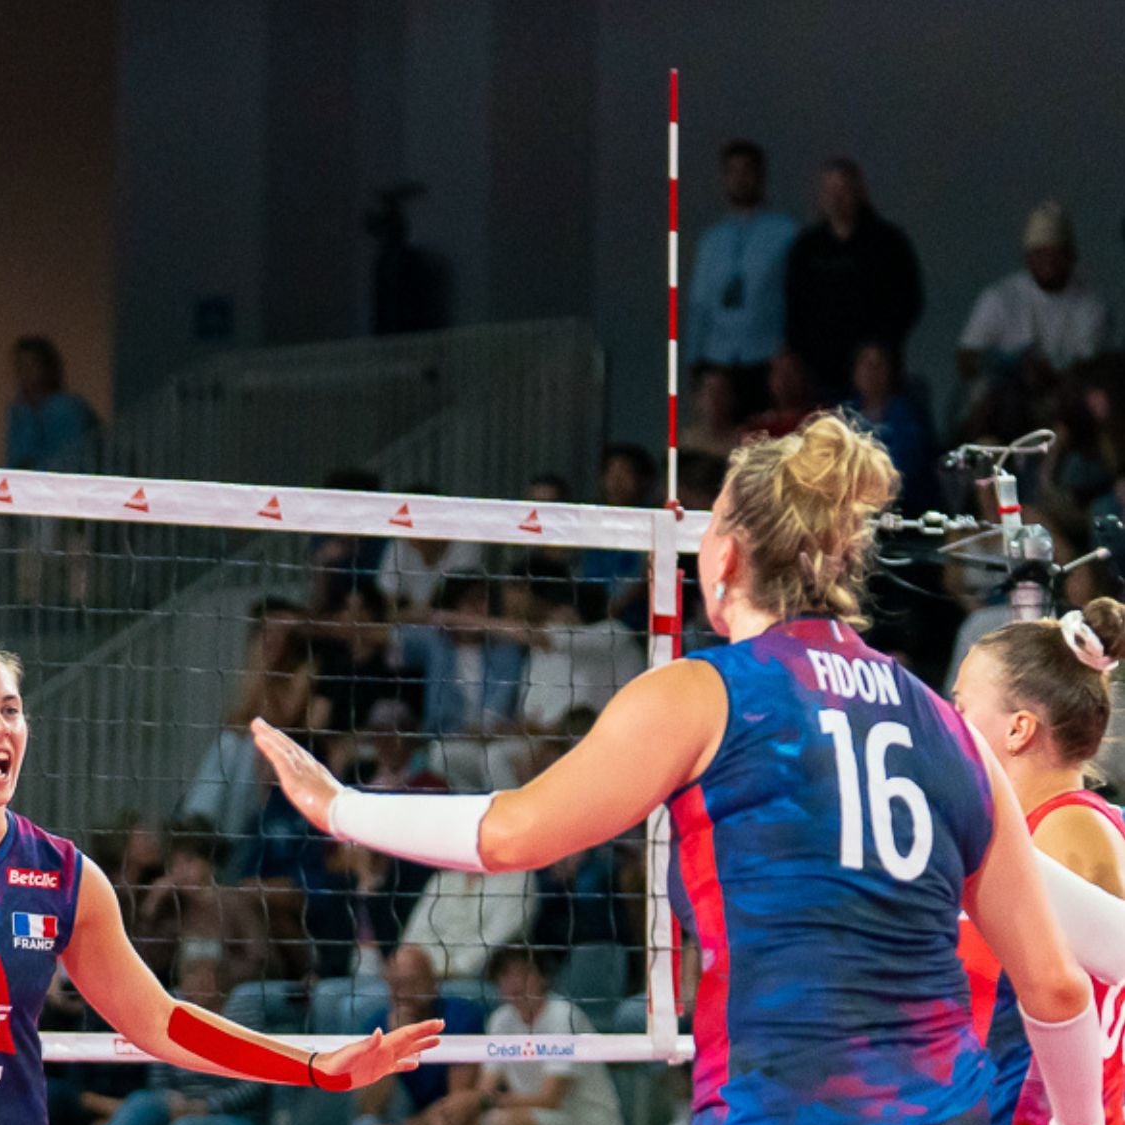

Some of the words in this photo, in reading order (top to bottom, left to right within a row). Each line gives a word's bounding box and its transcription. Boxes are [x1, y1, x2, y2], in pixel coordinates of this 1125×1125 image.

[807, 649, 901, 705] FIDON
[818, 708, 933, 882] 16
[8, 869, 58, 888] Betclic
[535, 1042, 575, 1056] Mutuel
